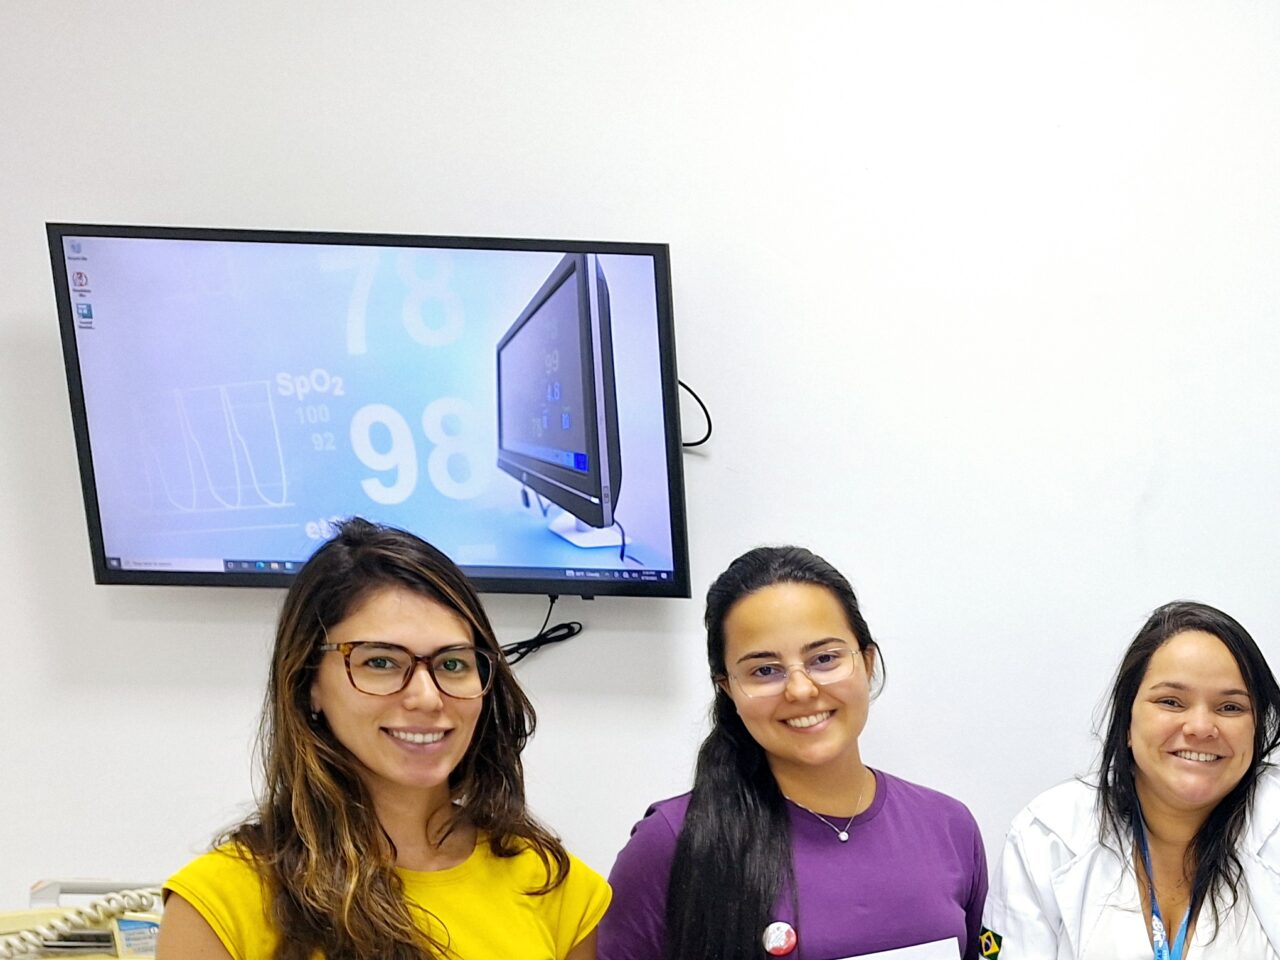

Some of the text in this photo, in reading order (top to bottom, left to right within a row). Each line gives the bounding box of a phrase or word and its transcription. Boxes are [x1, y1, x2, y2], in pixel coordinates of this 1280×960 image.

[320, 250, 464, 354] 78
[296, 405, 330, 424] 100
[312, 432, 336, 451] 92
[350, 397, 489, 504] 98
